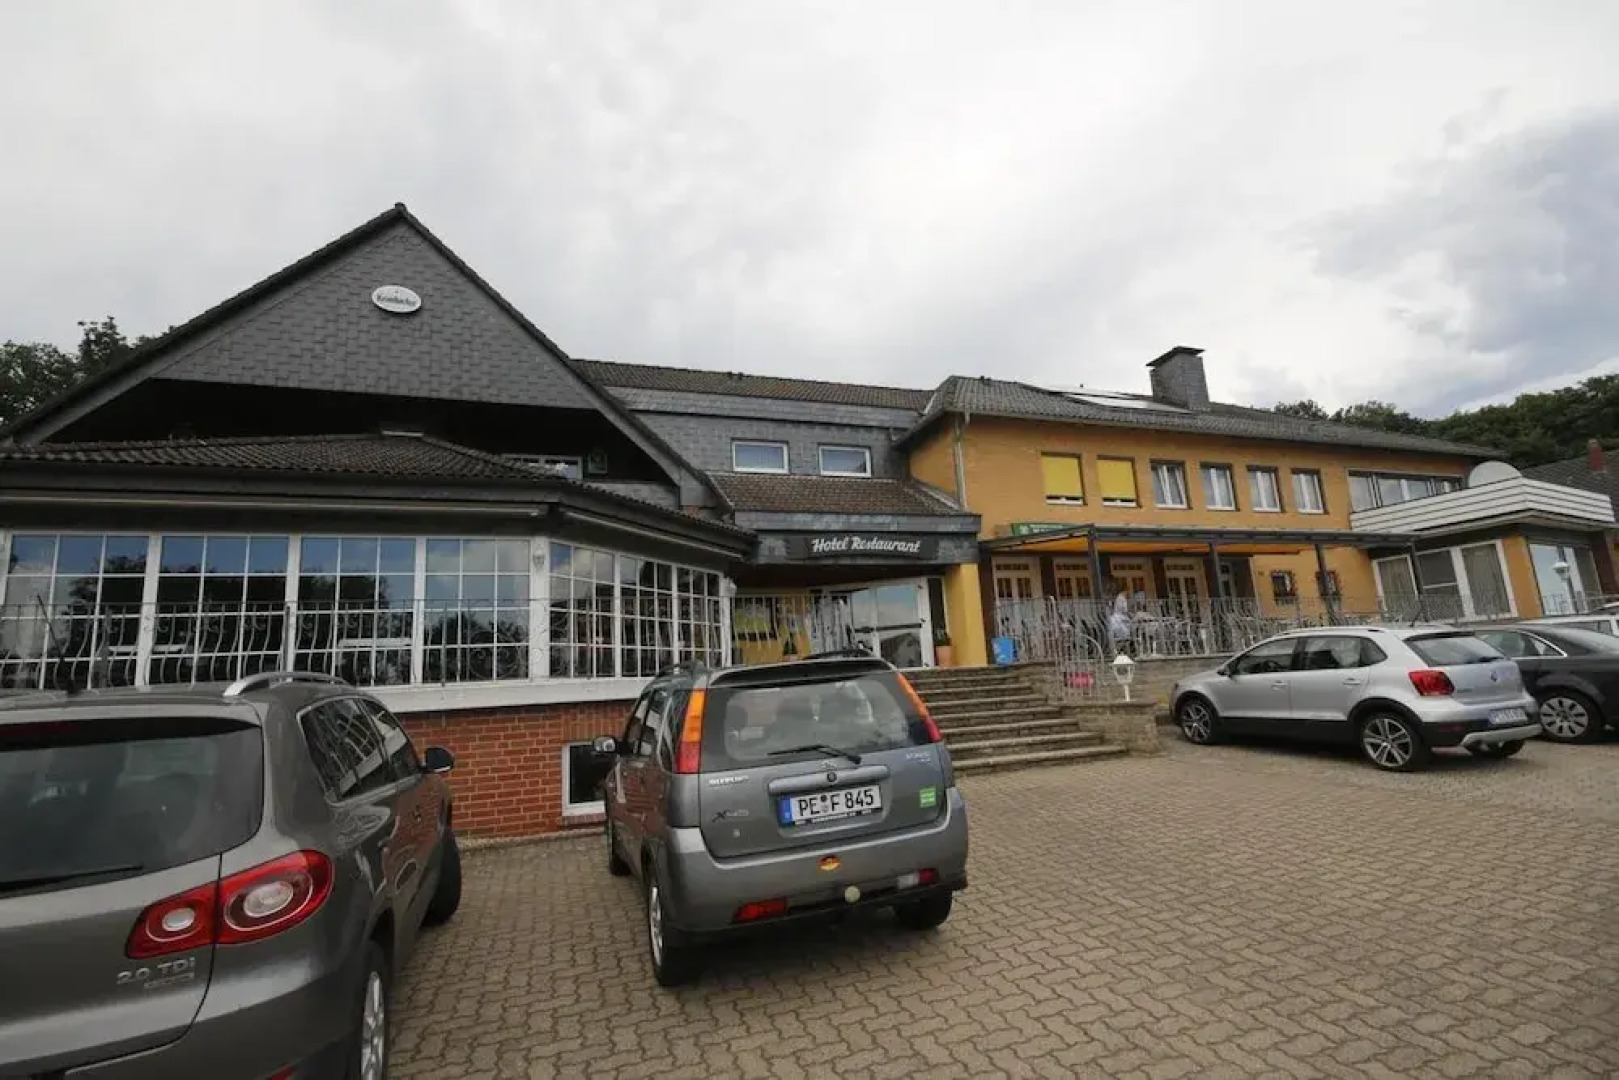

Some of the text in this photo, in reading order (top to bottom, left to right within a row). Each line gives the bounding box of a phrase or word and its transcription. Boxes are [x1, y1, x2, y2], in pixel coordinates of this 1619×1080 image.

[812, 536, 921, 553] Hotel Restaurant
[798, 797, 820, 816] PE
[845, 788, 874, 809] 845
